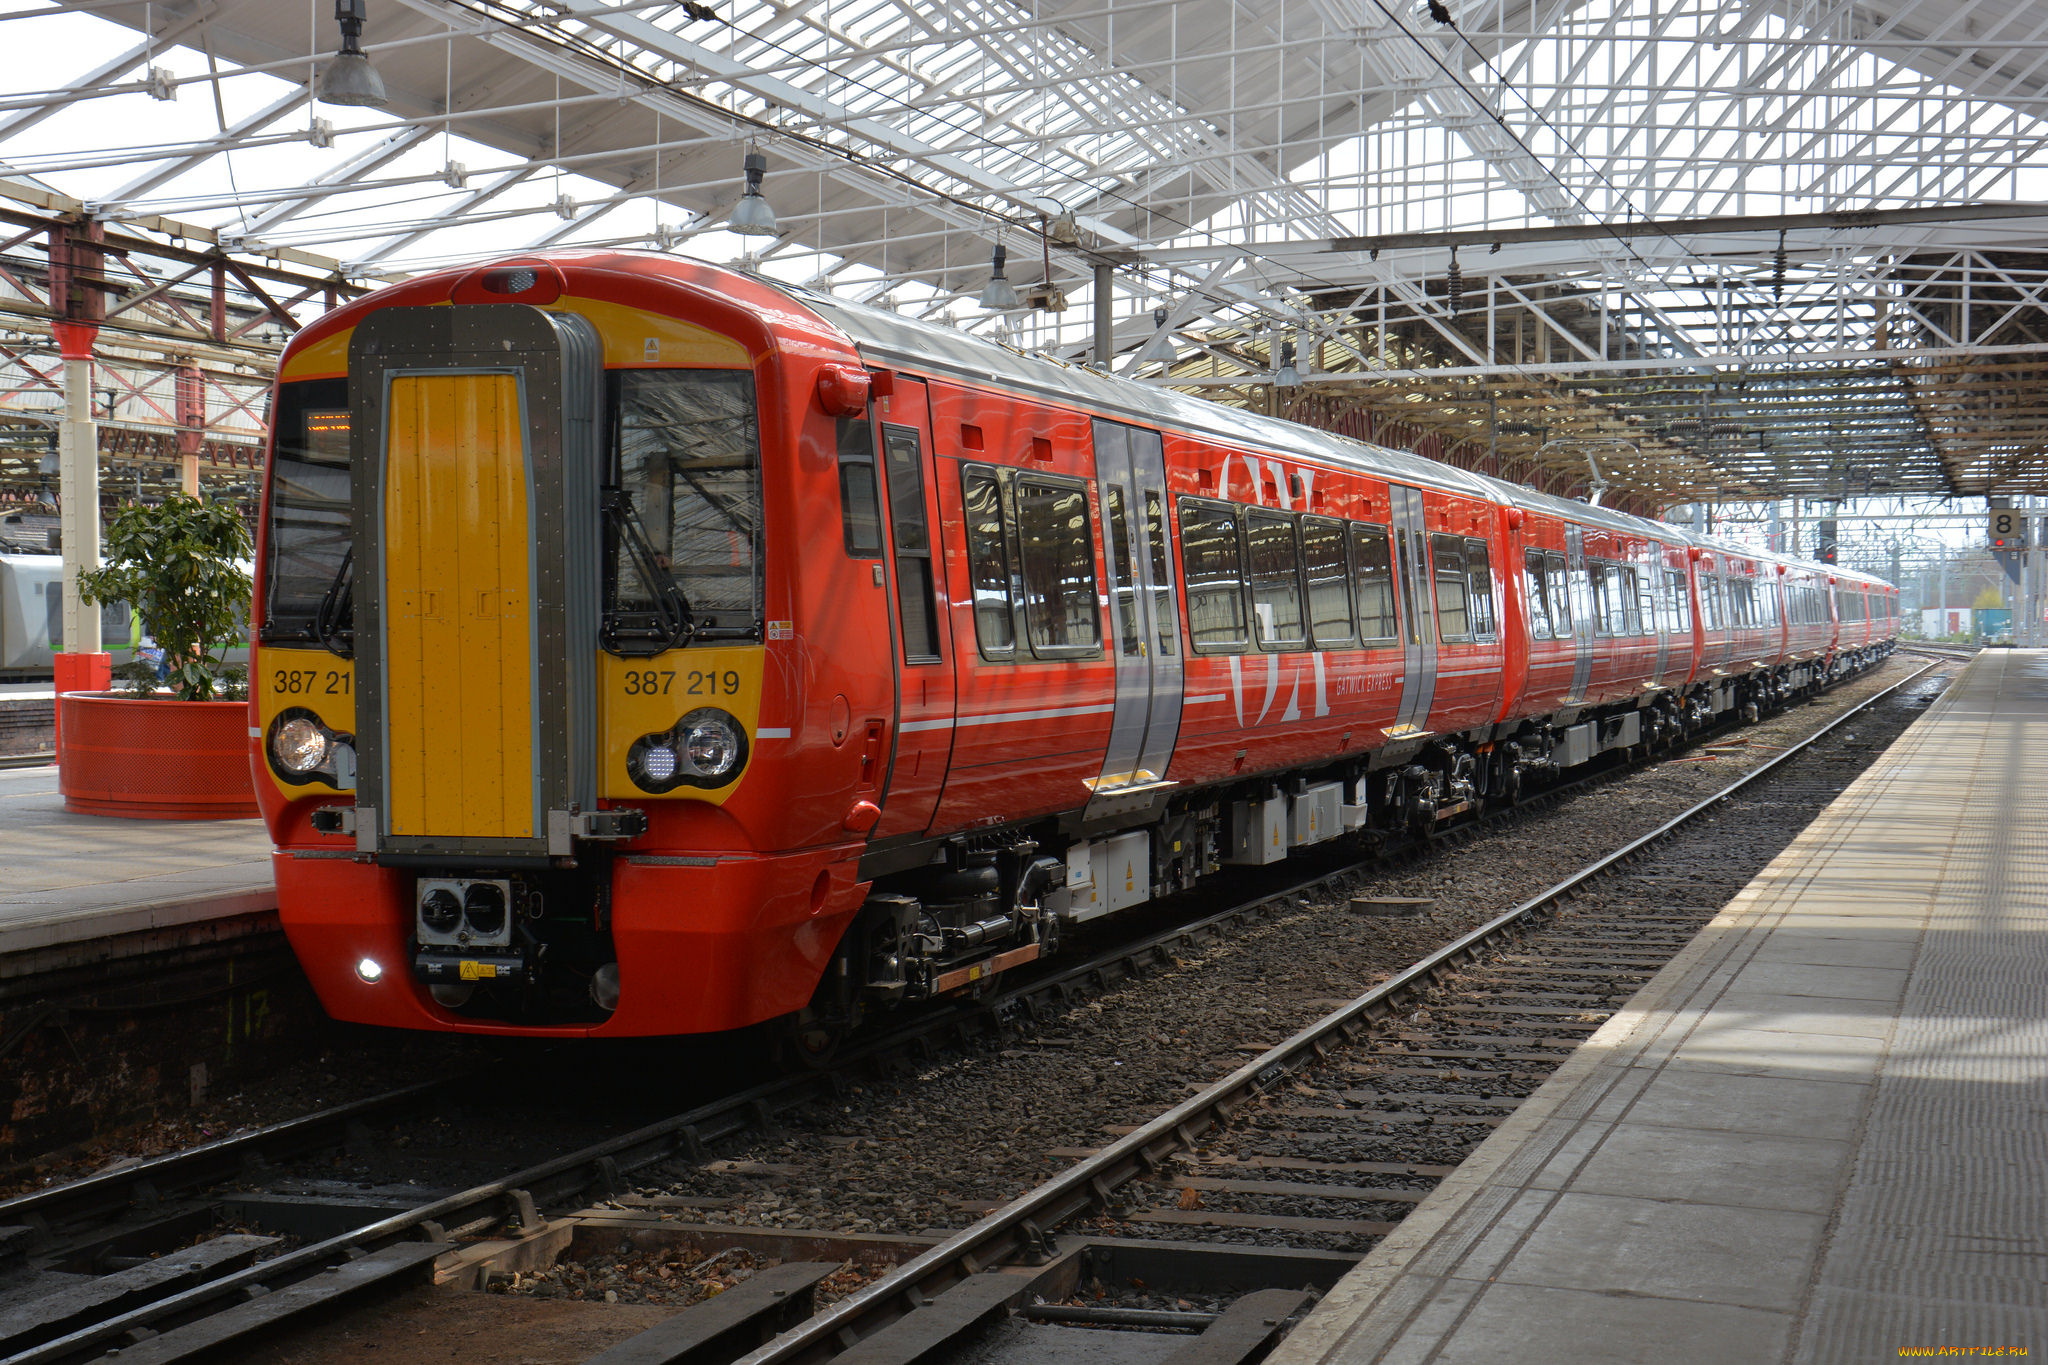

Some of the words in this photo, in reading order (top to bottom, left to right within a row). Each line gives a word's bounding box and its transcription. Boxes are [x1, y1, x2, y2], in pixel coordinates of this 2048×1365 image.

[1996, 514, 2012, 534] 8
[274, 670, 317, 694] 387
[624, 670, 676, 695] 387
[687, 670, 740, 695] 219
[1336, 674, 1365, 696] GATWICK
[1366, 671, 1393, 693] EXPRESS
